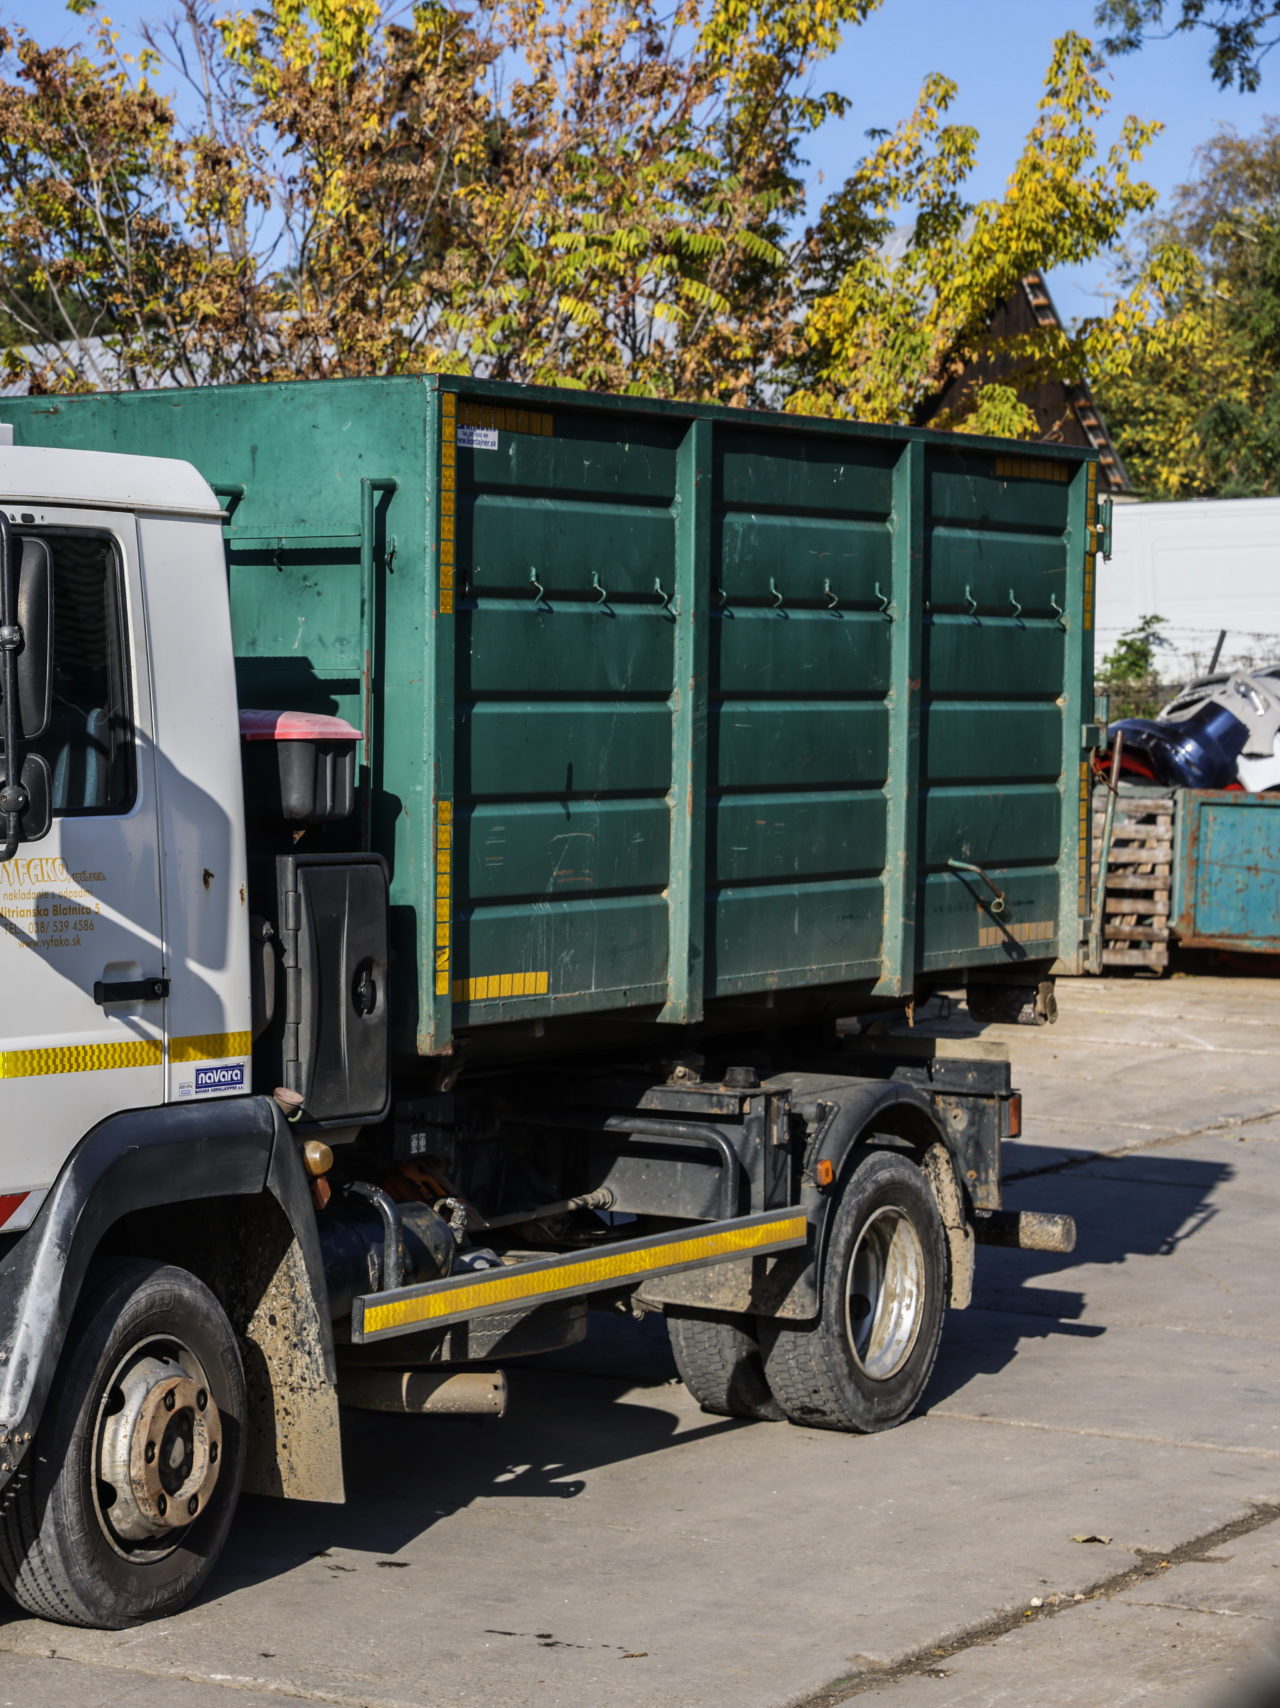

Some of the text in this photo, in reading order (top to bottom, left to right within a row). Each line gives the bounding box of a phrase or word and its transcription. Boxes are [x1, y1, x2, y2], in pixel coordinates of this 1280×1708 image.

[3, 888, 49, 901] nakladanie
[58, 887, 93, 902] odpadmi
[52, 904, 92, 917] Blatnica
[95, 903, 101, 915] 5
[53, 920, 69, 933] 539
[73, 919, 95, 932] 4586
[17, 935, 81, 950] www.vyfako.sk
